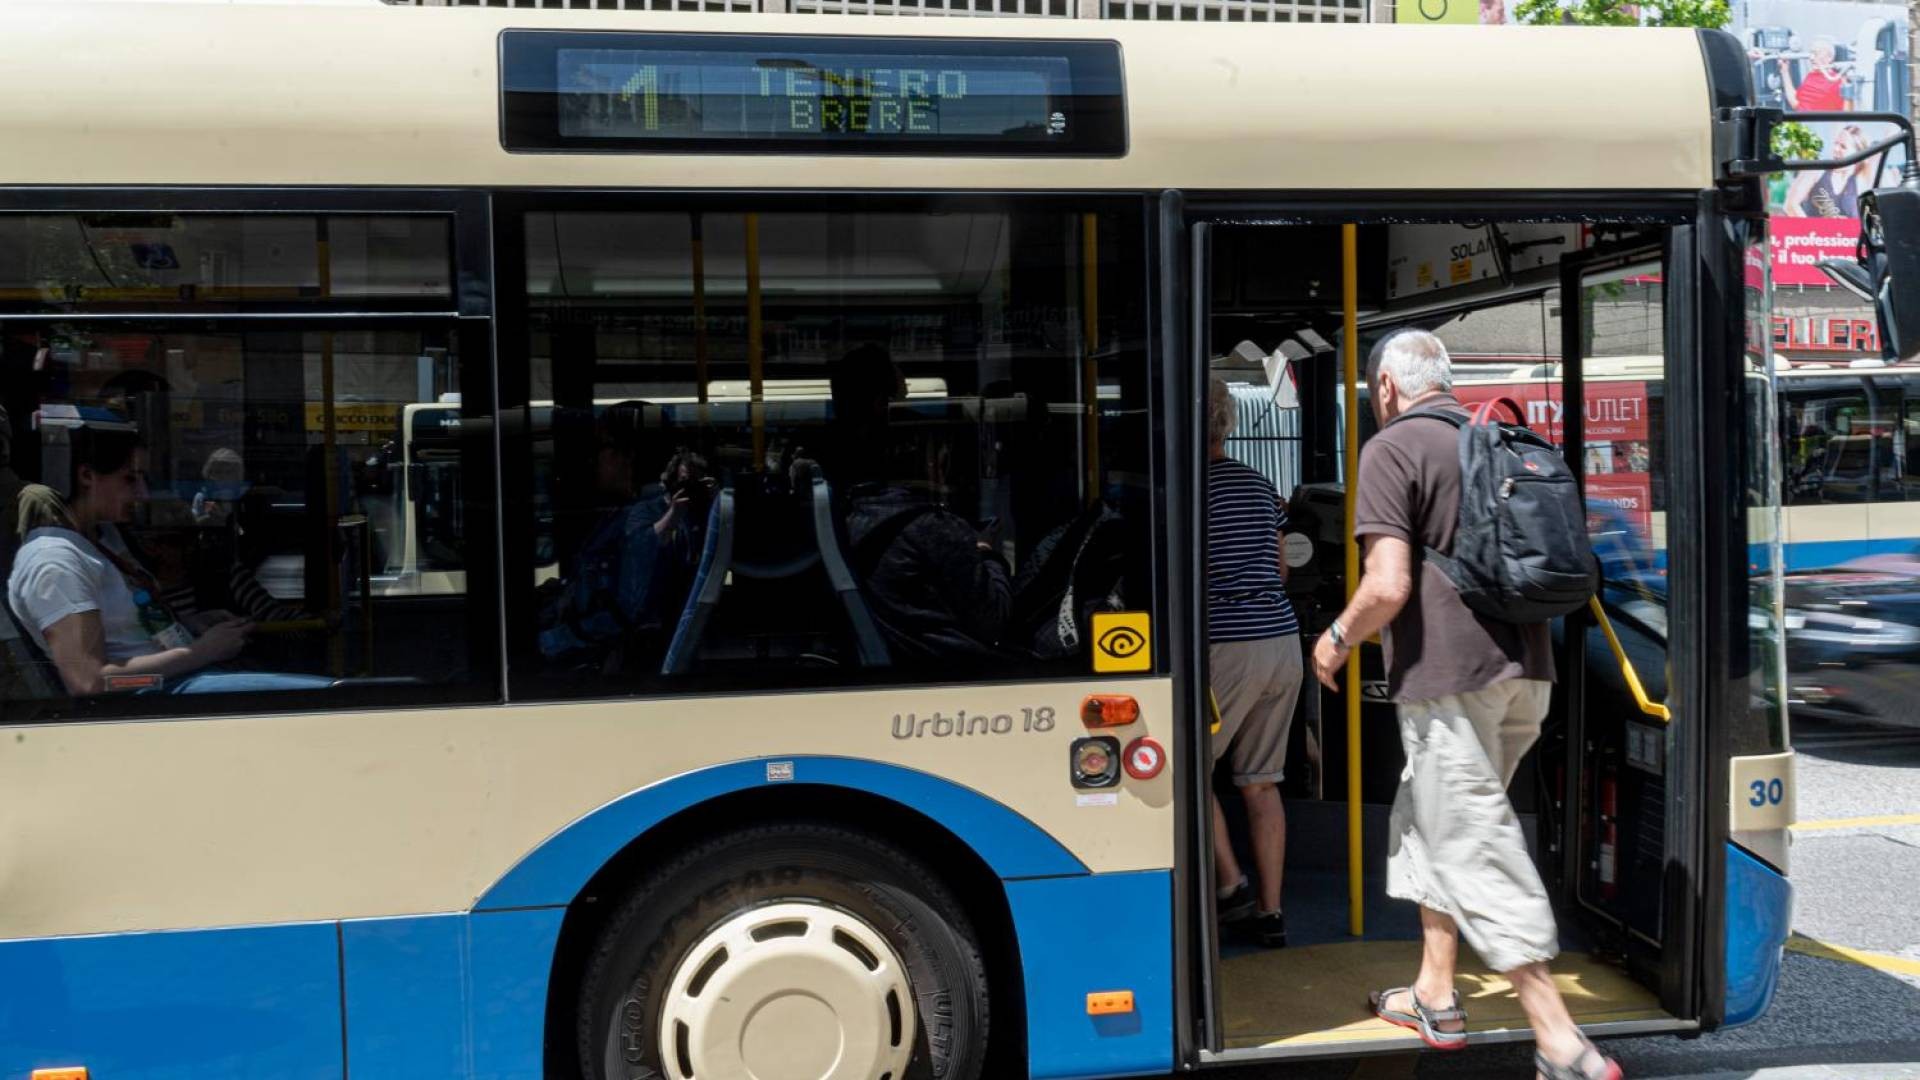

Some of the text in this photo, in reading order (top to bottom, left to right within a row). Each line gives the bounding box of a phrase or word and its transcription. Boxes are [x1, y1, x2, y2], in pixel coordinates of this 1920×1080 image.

[621, 65, 967, 130] 1 TENERO
[790, 99, 931, 130] BRERE
[1791, 252, 1816, 265] tuo
[1583, 397, 1642, 422] UTLET
[891, 706, 1056, 740] Urbino 18
[1749, 777, 1784, 807] 30
